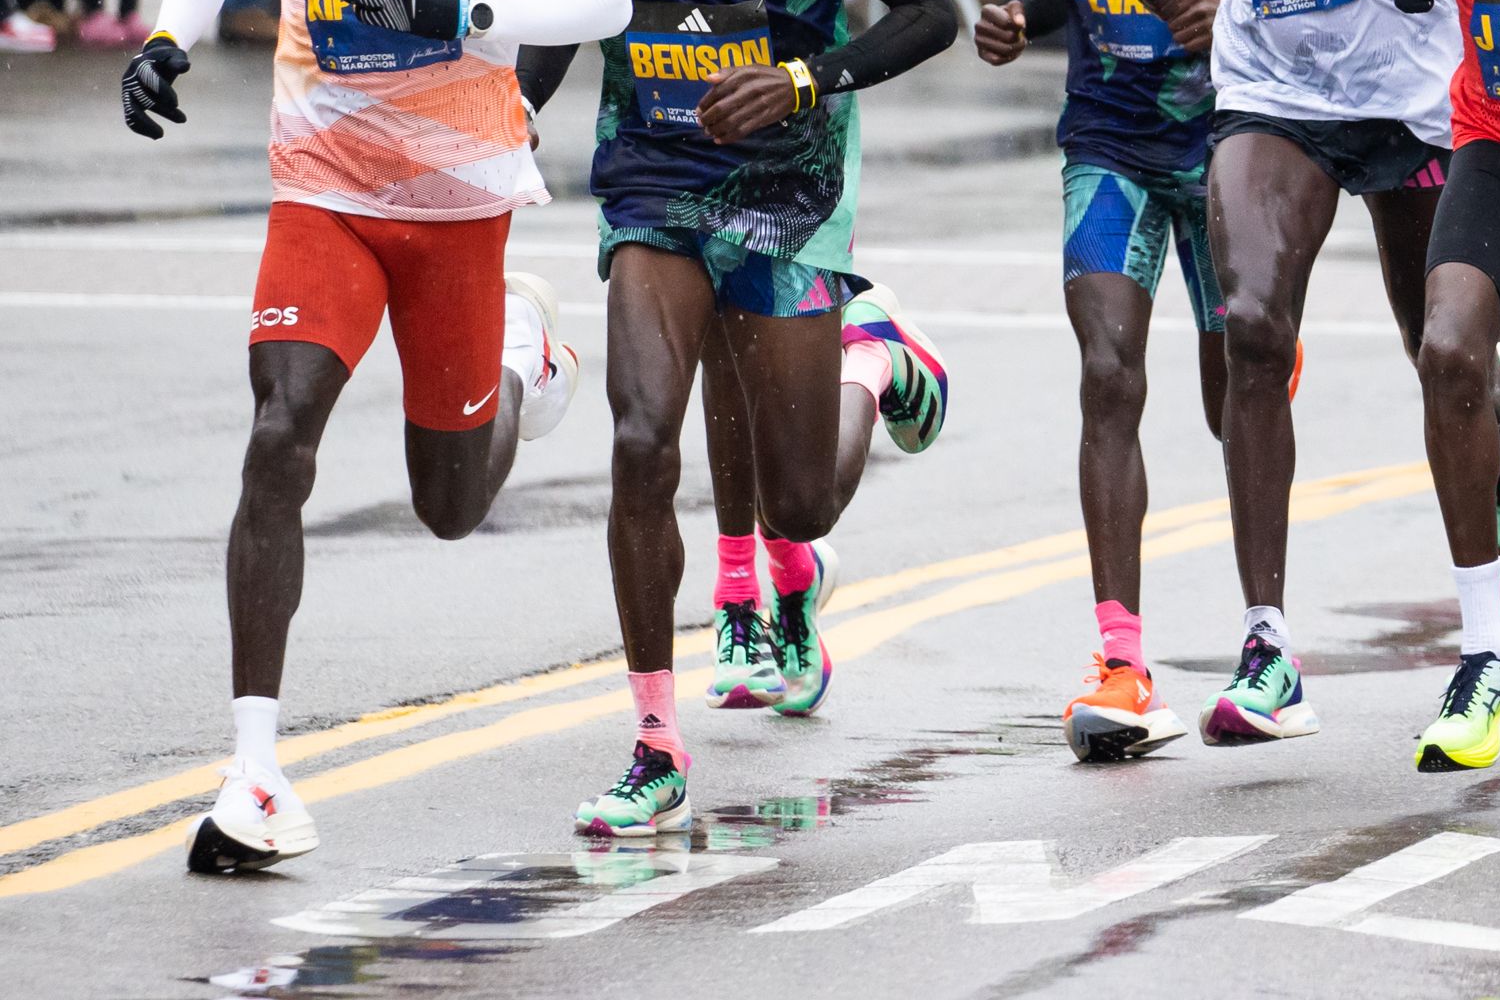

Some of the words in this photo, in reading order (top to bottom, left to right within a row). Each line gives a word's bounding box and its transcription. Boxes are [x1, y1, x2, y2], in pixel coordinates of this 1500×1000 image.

[1271, 1, 1317, 14] MARATHON
[1473, 14, 1495, 51] J
[359, 53, 396, 62] BOSTON
[629, 37, 772, 82] BENSON
[341, 61, 397, 71] MARATHON
[668, 114, 700, 125] MARAT
[250, 306, 299, 331] EOS
